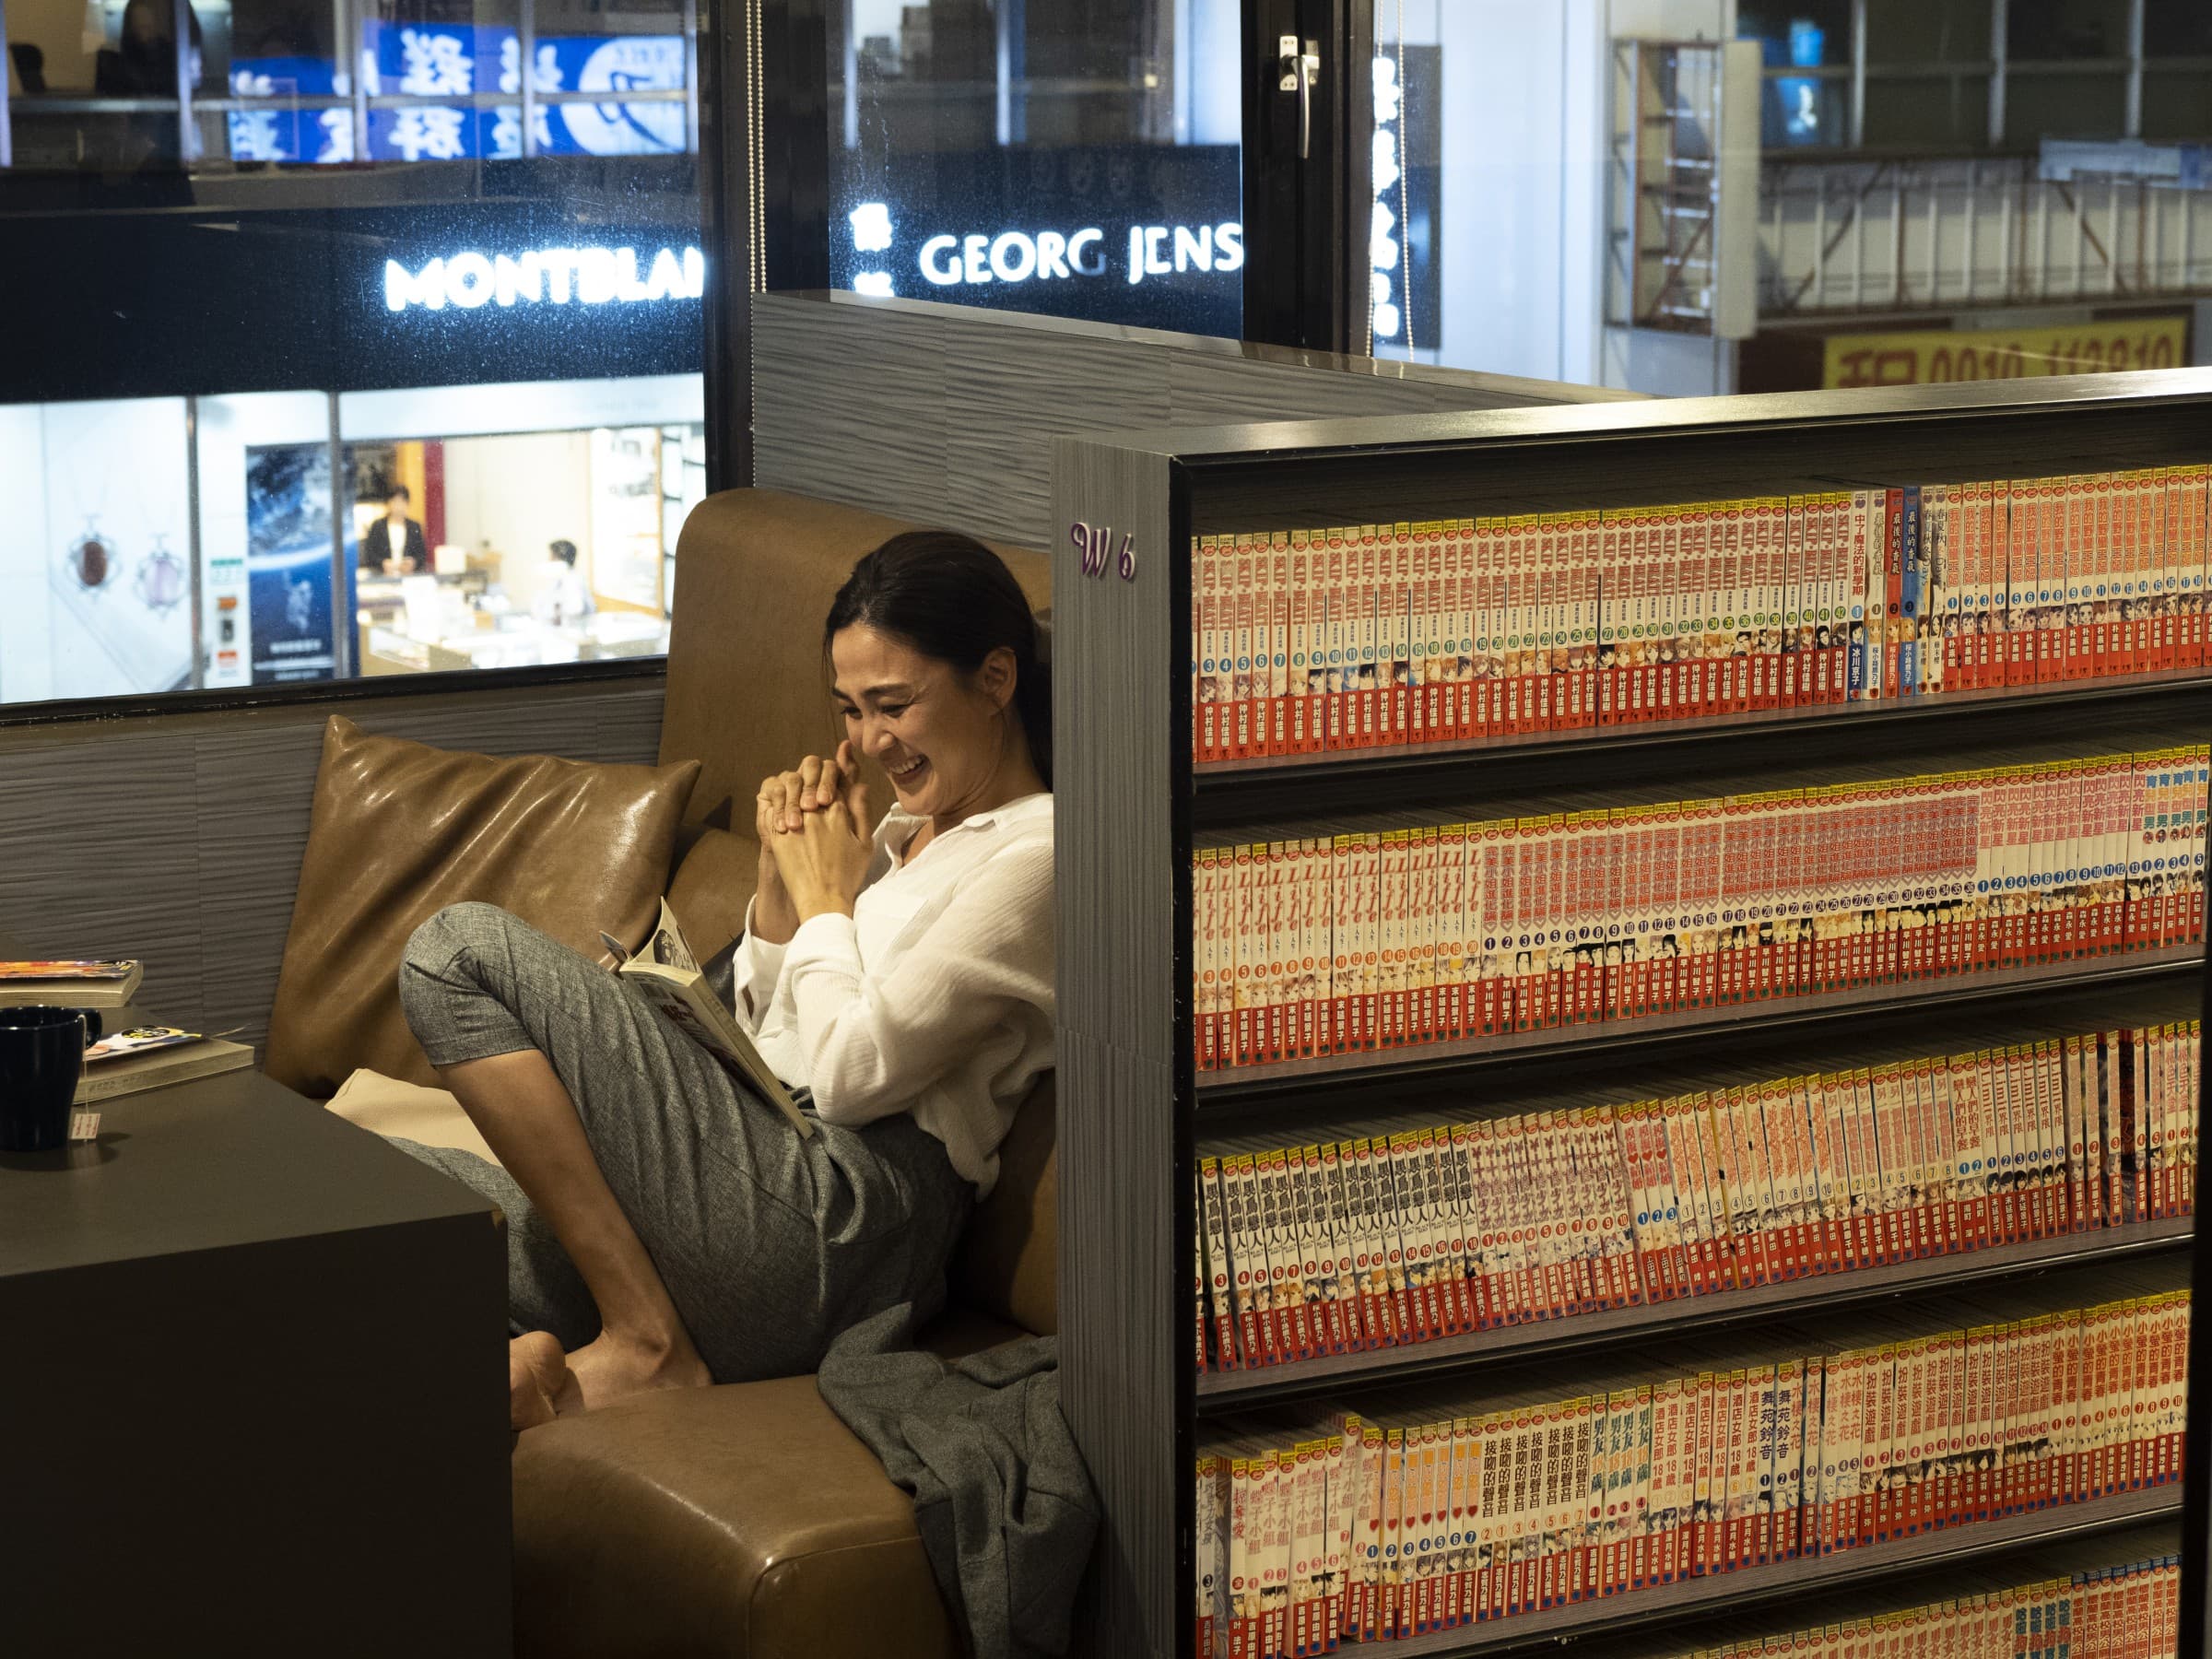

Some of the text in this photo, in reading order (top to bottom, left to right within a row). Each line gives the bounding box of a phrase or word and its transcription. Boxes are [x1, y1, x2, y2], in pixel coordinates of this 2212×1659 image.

[920, 228, 1106, 287] GEORG
[1128, 222, 1243, 285] JENS
[1071, 522, 1135, 580] W 6
[1852, 514, 1865, 595] 中了魔法的新學期
[1482, 1440, 1497, 1518] 接吻的聲音
[1498, 1438, 1512, 1514] 接吻的聲音
[1514, 1434, 1528, 1512] 接吻的聲音
[1530, 1431, 1542, 1509] 接吻的聲音
[1547, 1428, 1559, 1505] 接吻的聲音
[1560, 1426, 1574, 1502] 接吻的聲音
[1576, 1423, 1588, 1499] 接吻的聲音
